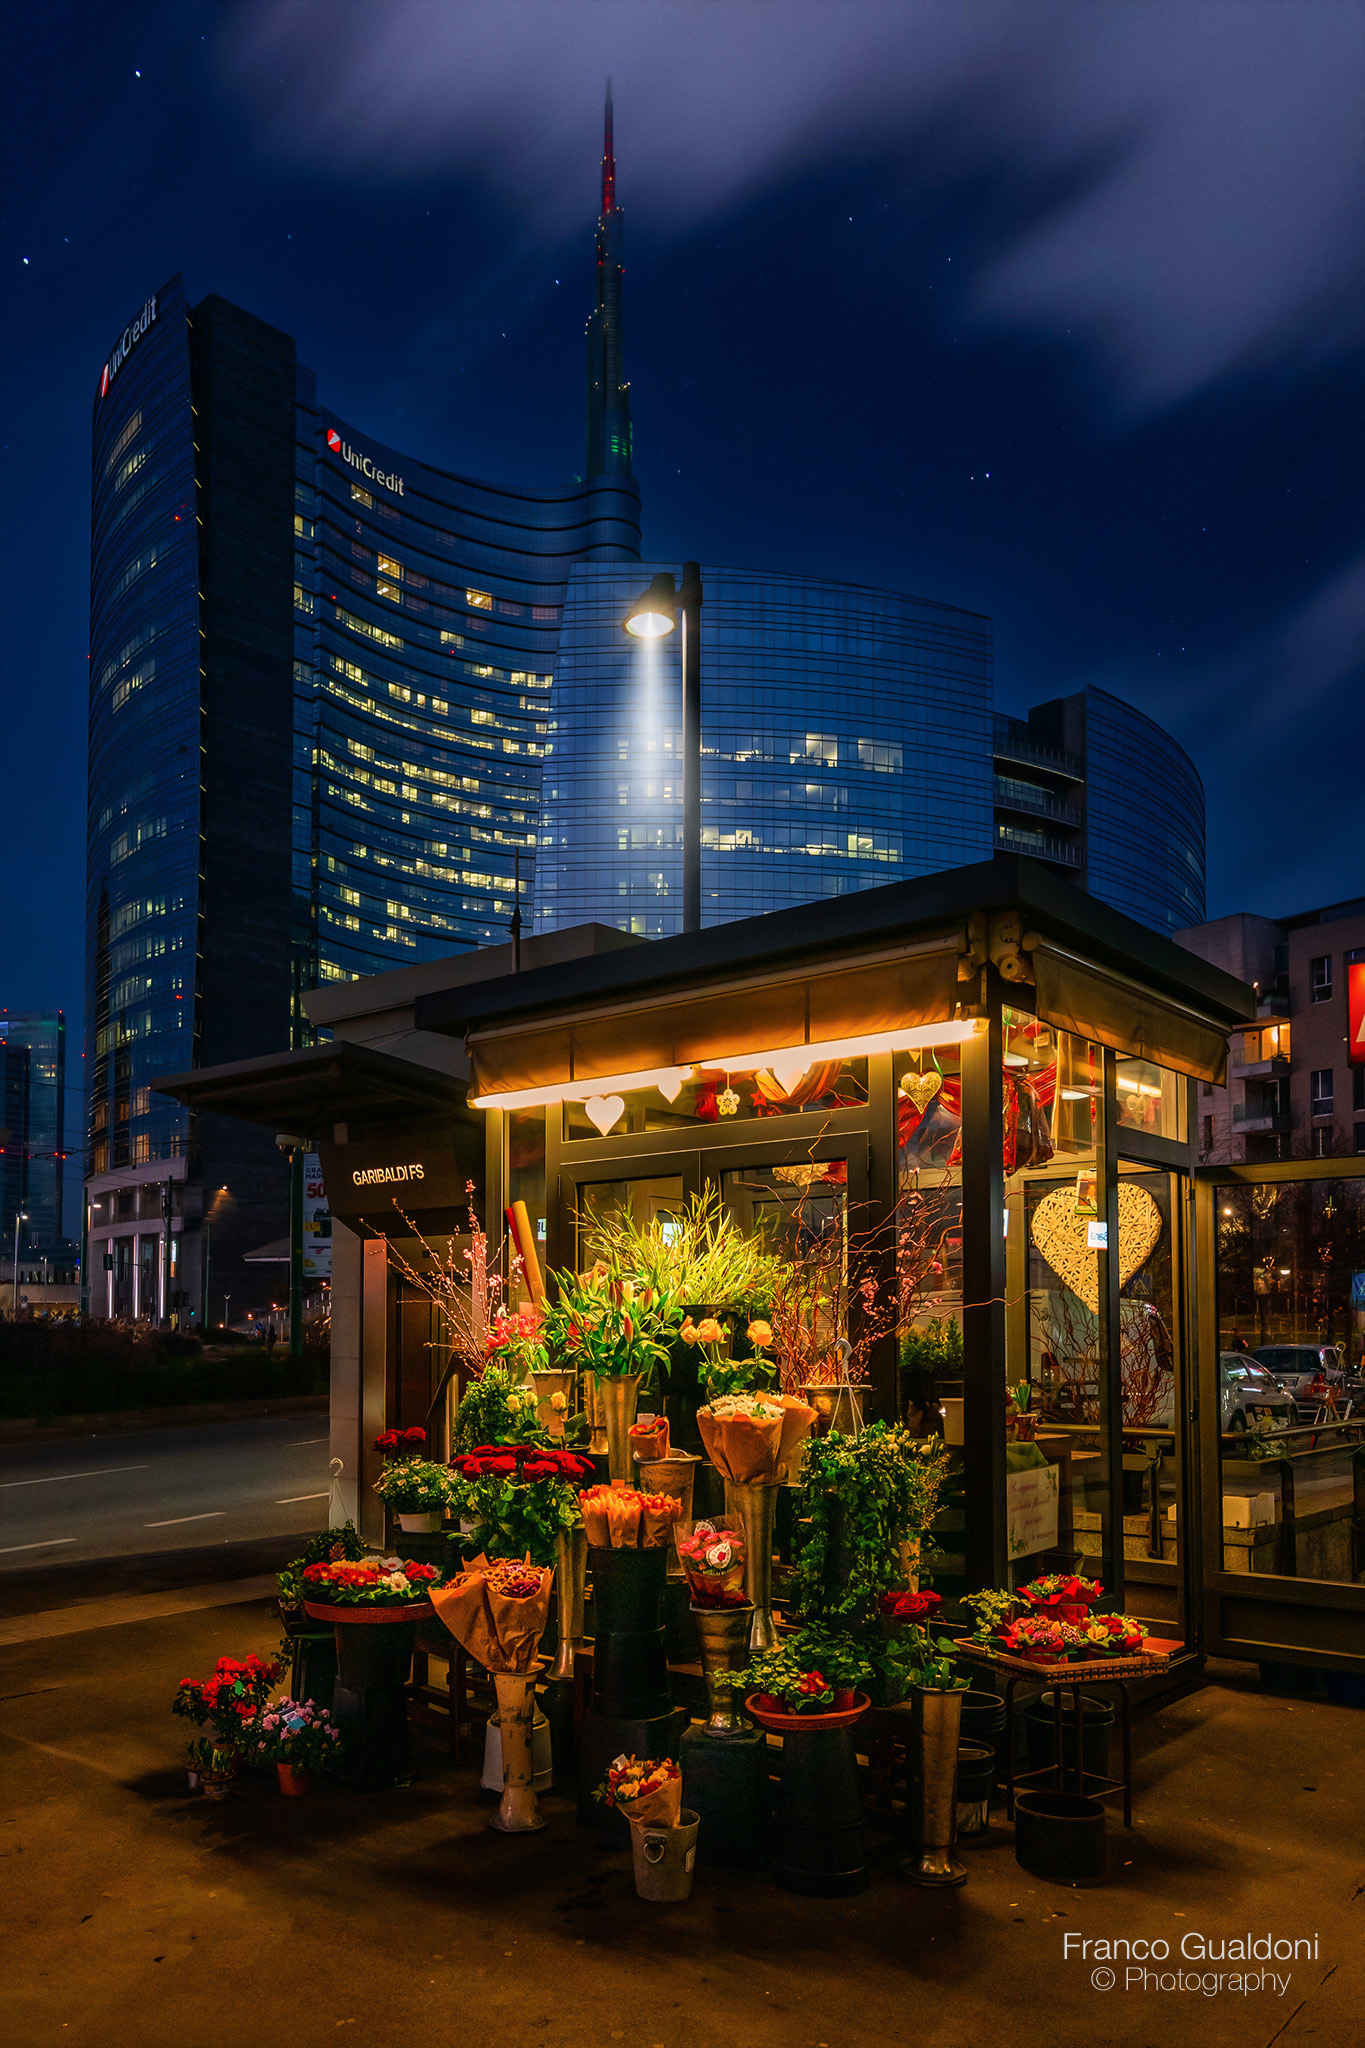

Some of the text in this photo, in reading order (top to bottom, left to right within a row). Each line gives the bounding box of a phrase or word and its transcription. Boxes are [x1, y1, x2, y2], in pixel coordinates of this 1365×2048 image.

[108, 294, 157, 382] UniCredit
[342, 441, 404, 497] UniCredit
[352, 1163, 425, 1186] GARIBALDI FS
